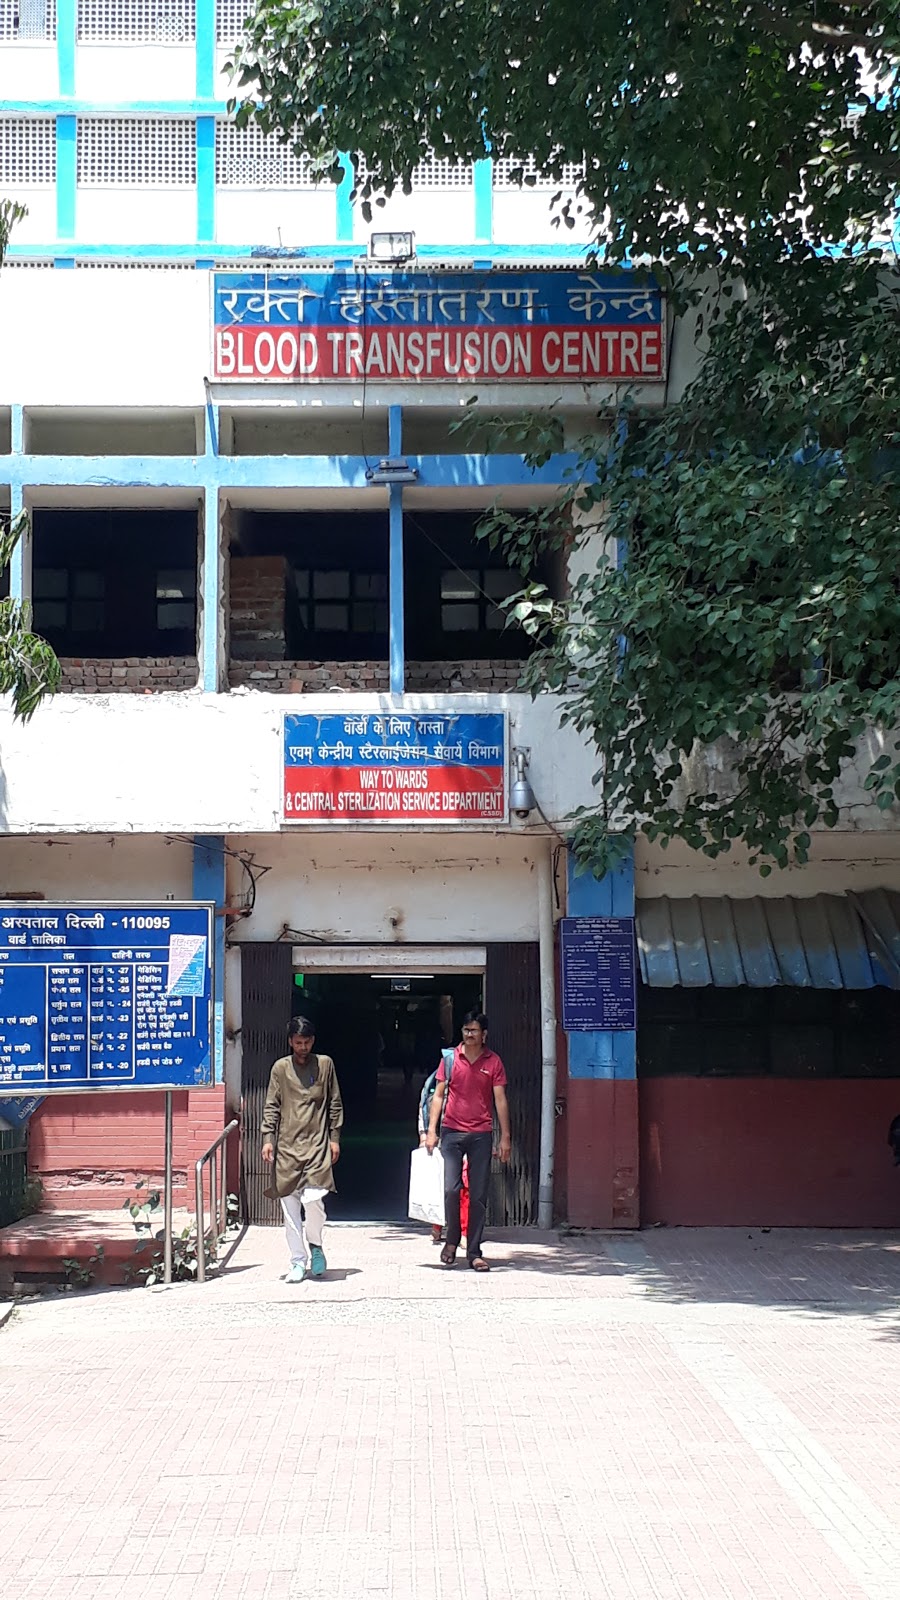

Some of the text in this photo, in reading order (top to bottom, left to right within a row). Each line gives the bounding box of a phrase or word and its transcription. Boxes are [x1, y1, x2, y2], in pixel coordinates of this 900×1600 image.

[217, 288, 304, 322] रक्त
[566, 275, 658, 321] केन्द्र
[216, 330, 658, 375] BLOOD TRANSFUSION CENTRE
[389, 716, 411, 738] लिए
[417, 721, 445, 735] रास्ता
[288, 746, 314, 765] एवम्
[317, 741, 354, 761] केन्द्रीय
[467, 741, 499, 760] विभाग
[359, 770, 429, 789] WAY TO WARDS
[285, 791, 502, 811] & CENTRAL STERLIZATION SERVICE DEPARTMENT
[1, 916, 59, 930] अस्पताल
[65, 912, 105, 930] दिल्ली
[121, 917, 171, 929] 110095
[8, 932, 67, 945] वार्ड तालिका
